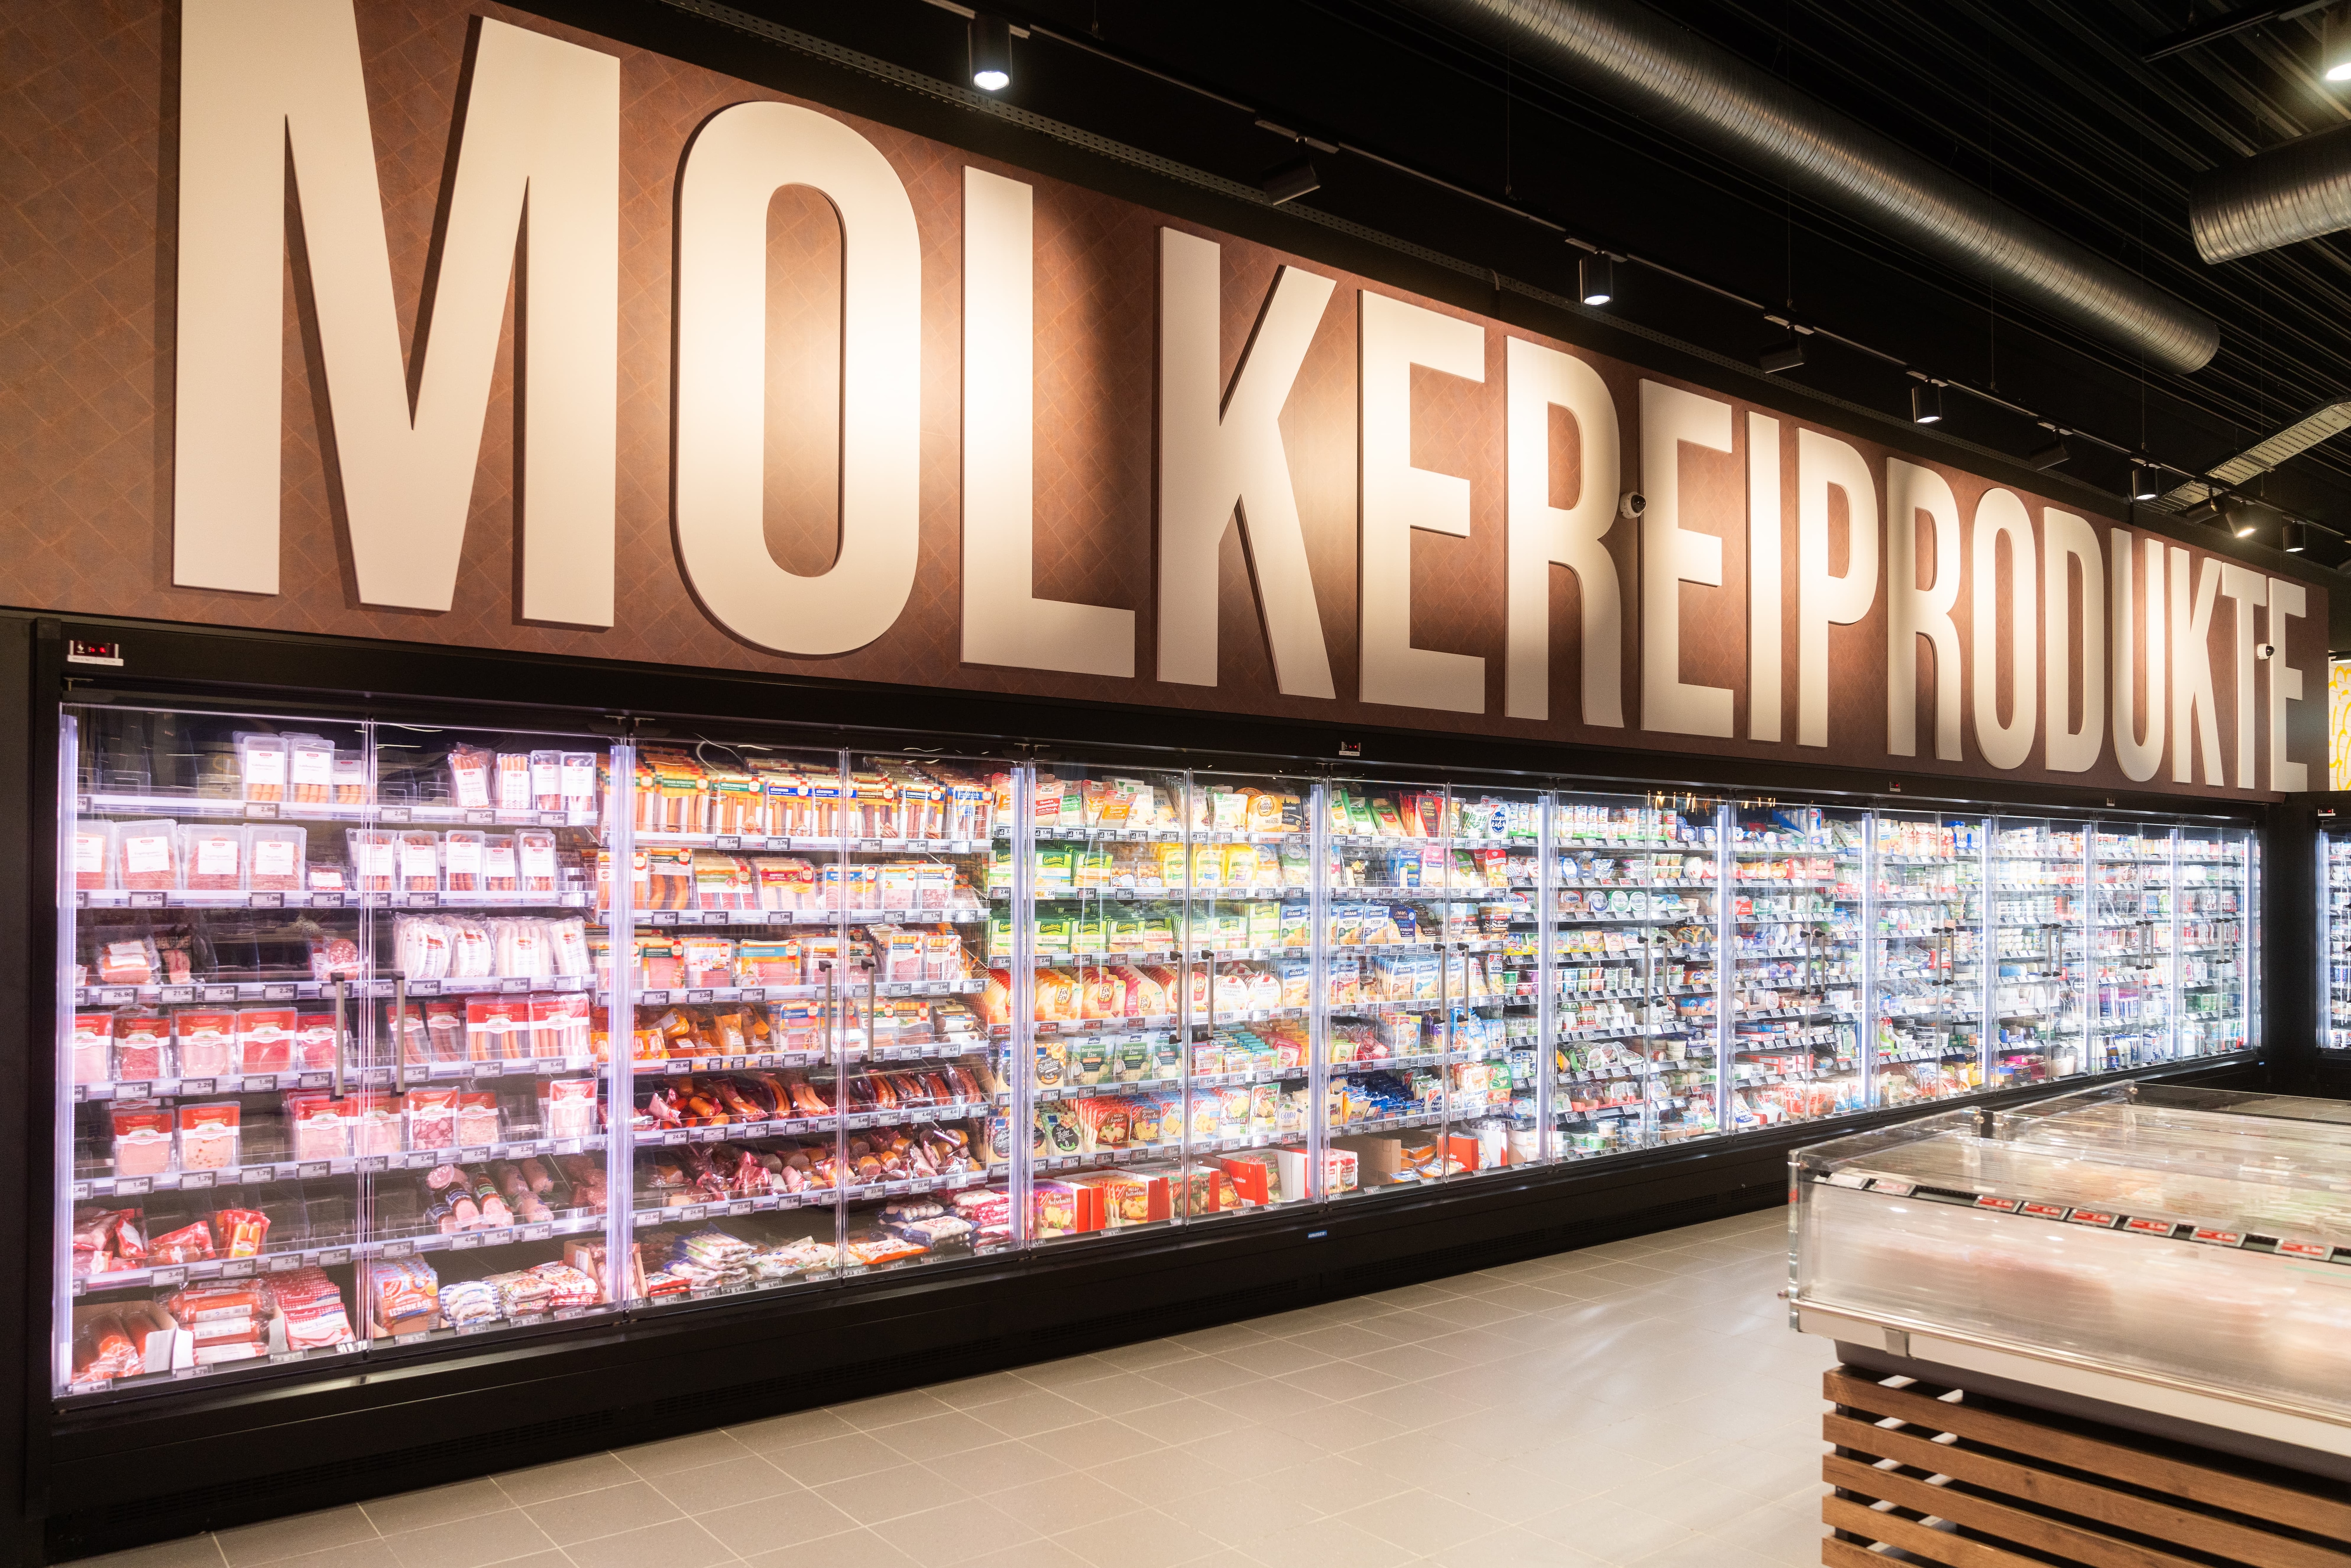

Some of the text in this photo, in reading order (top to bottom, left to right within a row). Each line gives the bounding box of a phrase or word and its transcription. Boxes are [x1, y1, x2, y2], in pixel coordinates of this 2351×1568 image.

[173, 0, 2307, 792] MOLKEREIPRODUKTE
[1058, 992, 1067, 1001] Epi
[1100, 990, 1109, 1000] Epi
[1038, 1060, 1059, 1070] Butterkäse
[389, 1299, 433, 1316] LEBERKÄSE
